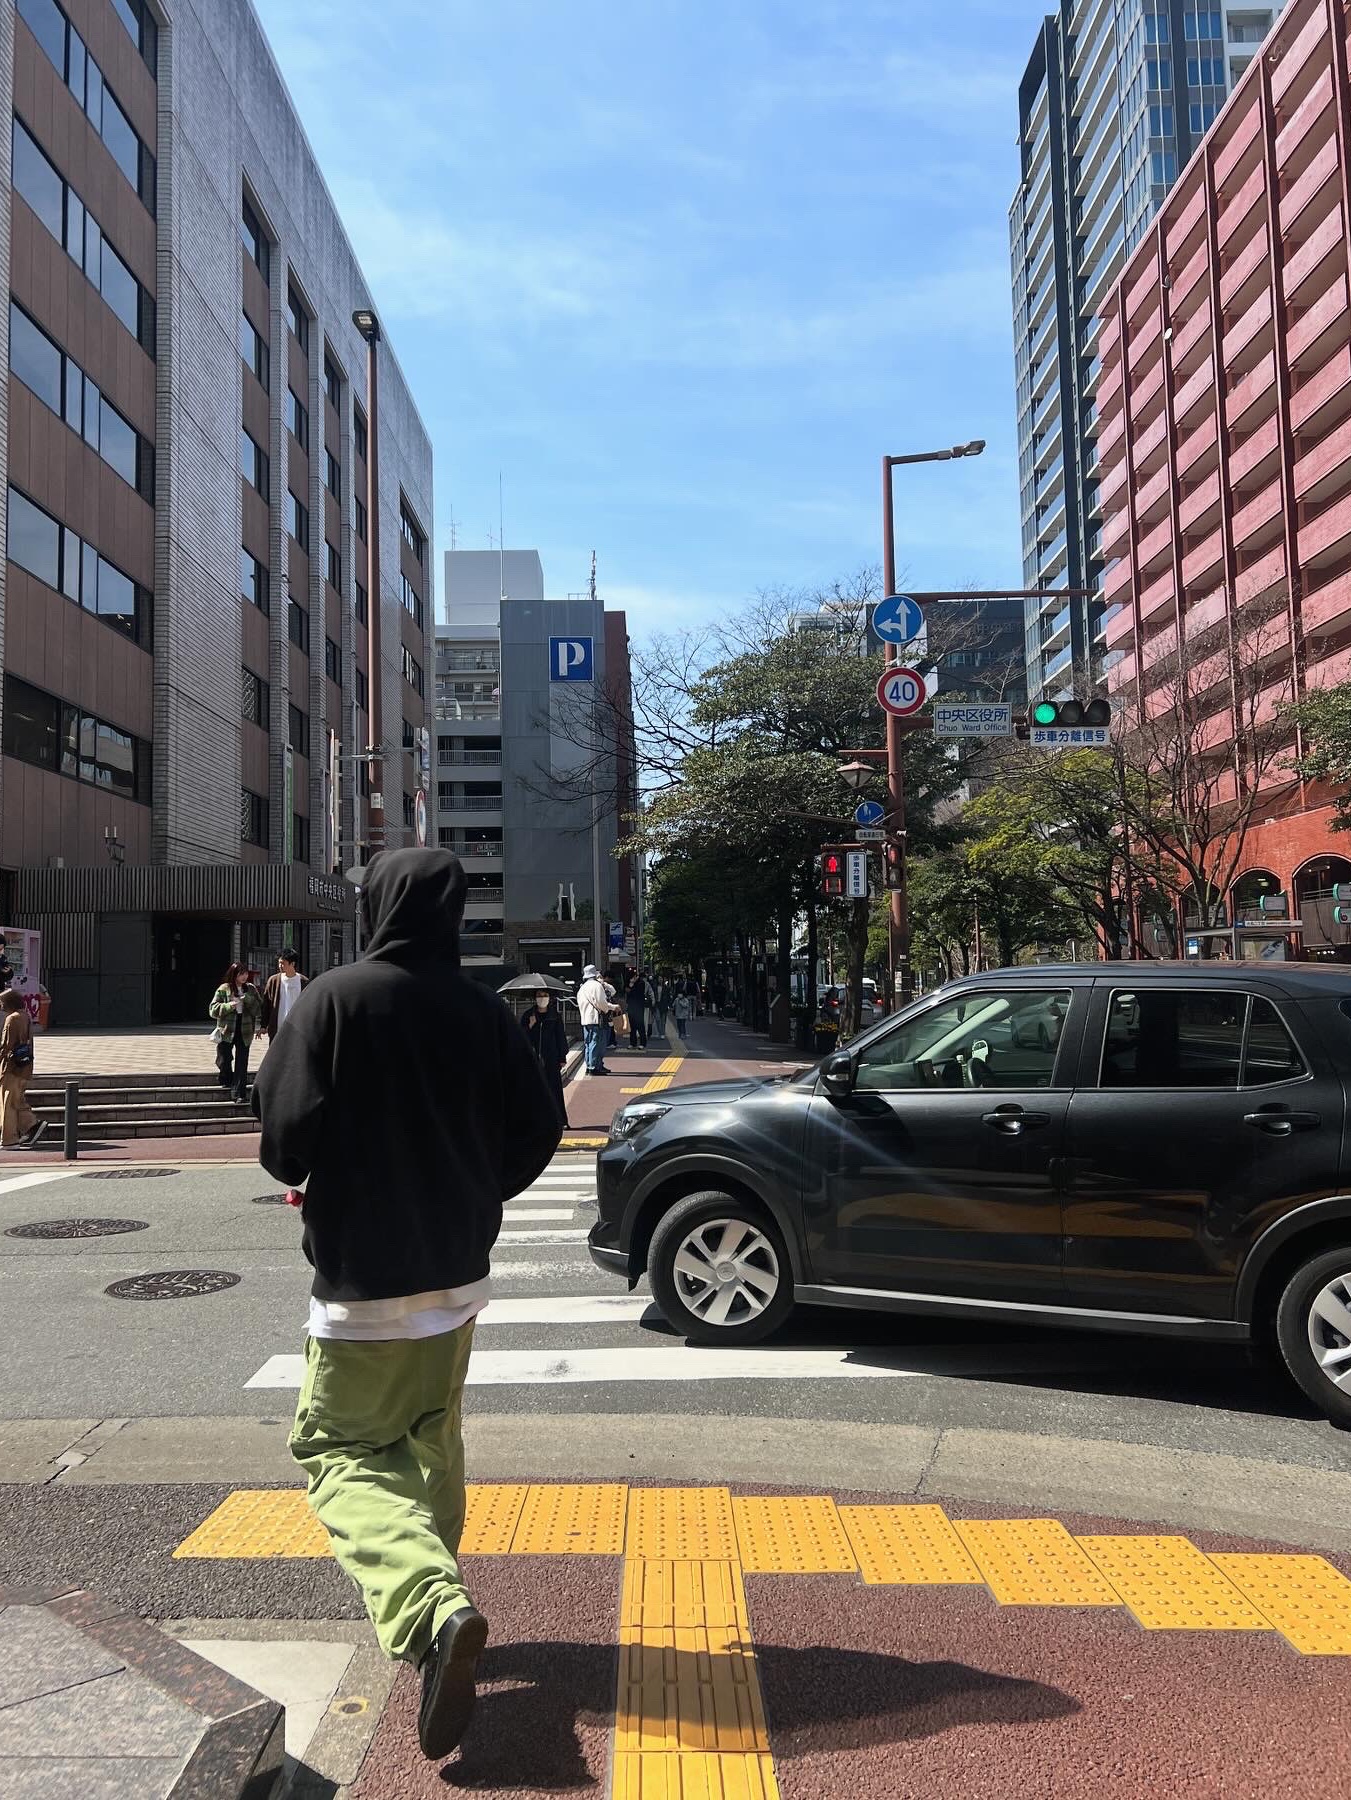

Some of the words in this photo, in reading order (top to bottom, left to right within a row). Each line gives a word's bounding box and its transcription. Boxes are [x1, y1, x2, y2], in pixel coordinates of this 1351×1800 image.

[558, 642, 585, 676] P
[889, 681, 915, 701] 40
[937, 708, 1008, 722] 中央区役所
[938, 724, 958, 732] Chuo
[962, 724, 981, 732] Ward
[984, 723, 1007, 731] Office
[1034, 729, 1106, 743] 歩車分離信号
